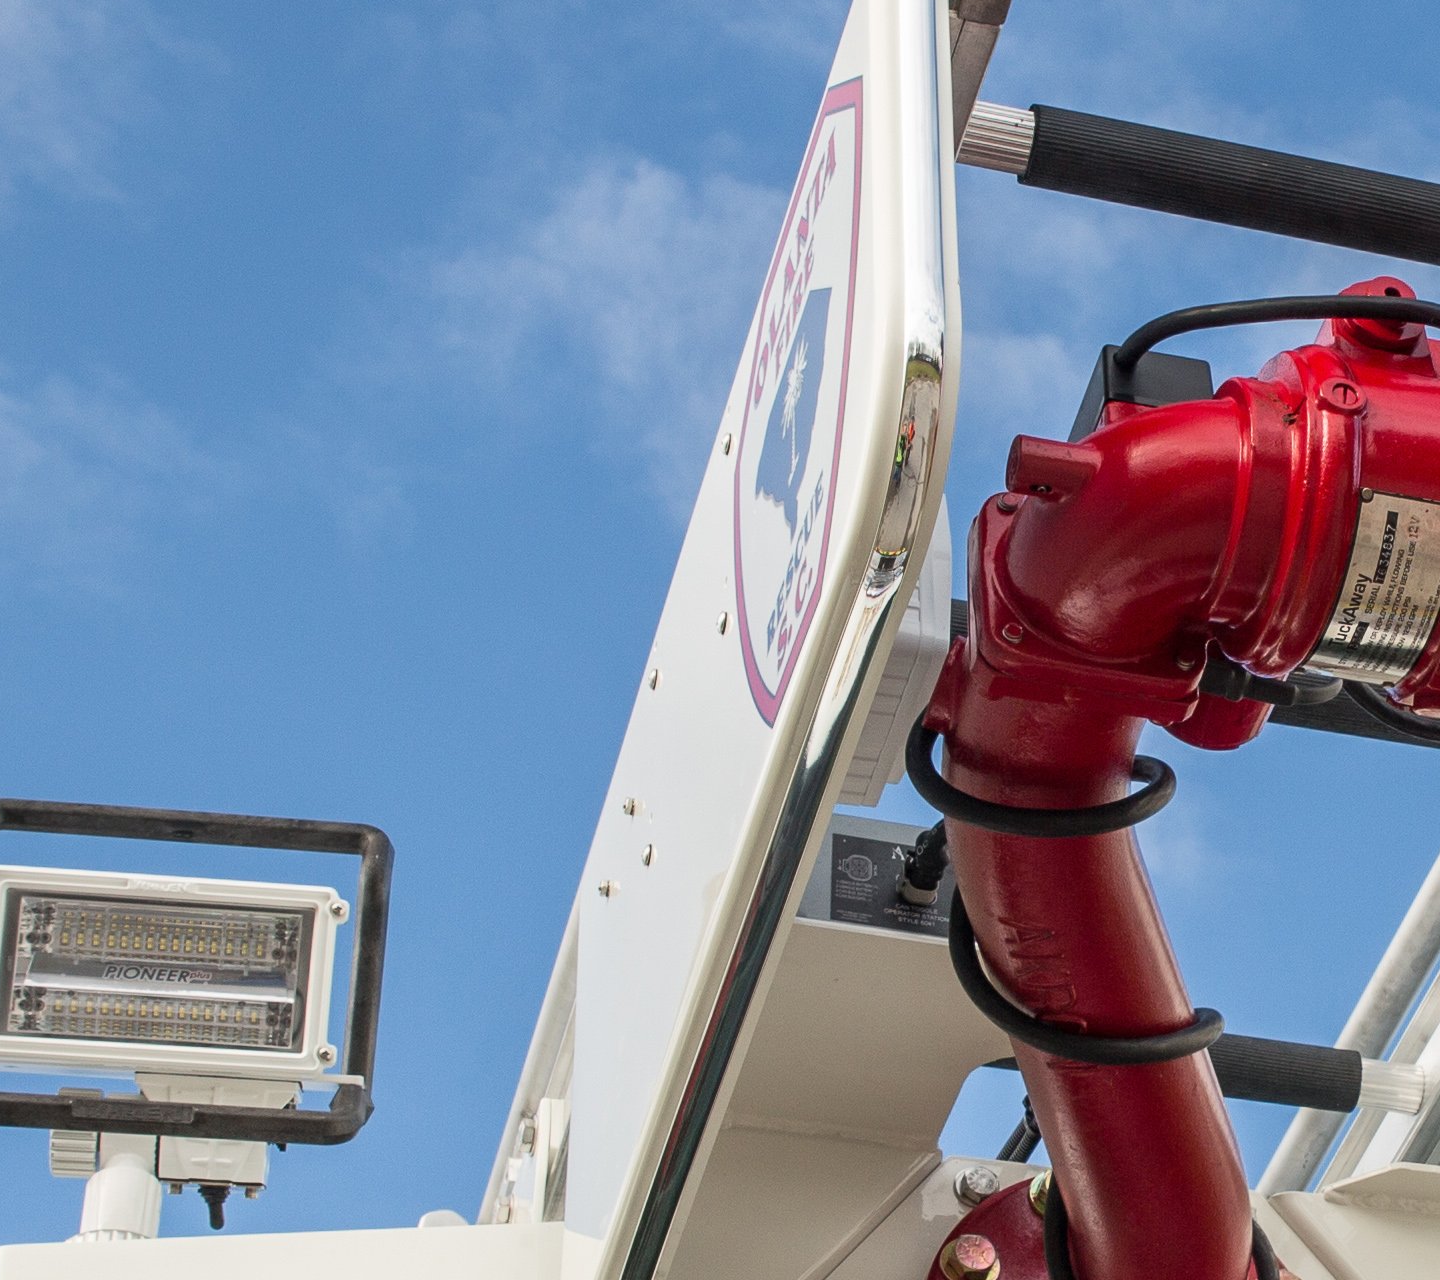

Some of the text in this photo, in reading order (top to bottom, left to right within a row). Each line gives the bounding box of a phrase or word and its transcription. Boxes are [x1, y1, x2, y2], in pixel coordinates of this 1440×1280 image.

[754, 126, 836, 410] OLANTA
[774, 233, 815, 387] FIRE
[766, 470, 824, 657] RESCUE
[1399, 557, 1413, 586] BEFORE
[1407, 541, 1417, 557] USE
[1327, 573, 1373, 646] TuckAway
[1364, 585, 1380, 614] SERIAL
[884, 908, 920, 918] OPERATOR
[922, 913, 950, 923] STATION
[898, 916, 918, 925] STYLE
[104, 965, 211, 983] PIONEER plus
